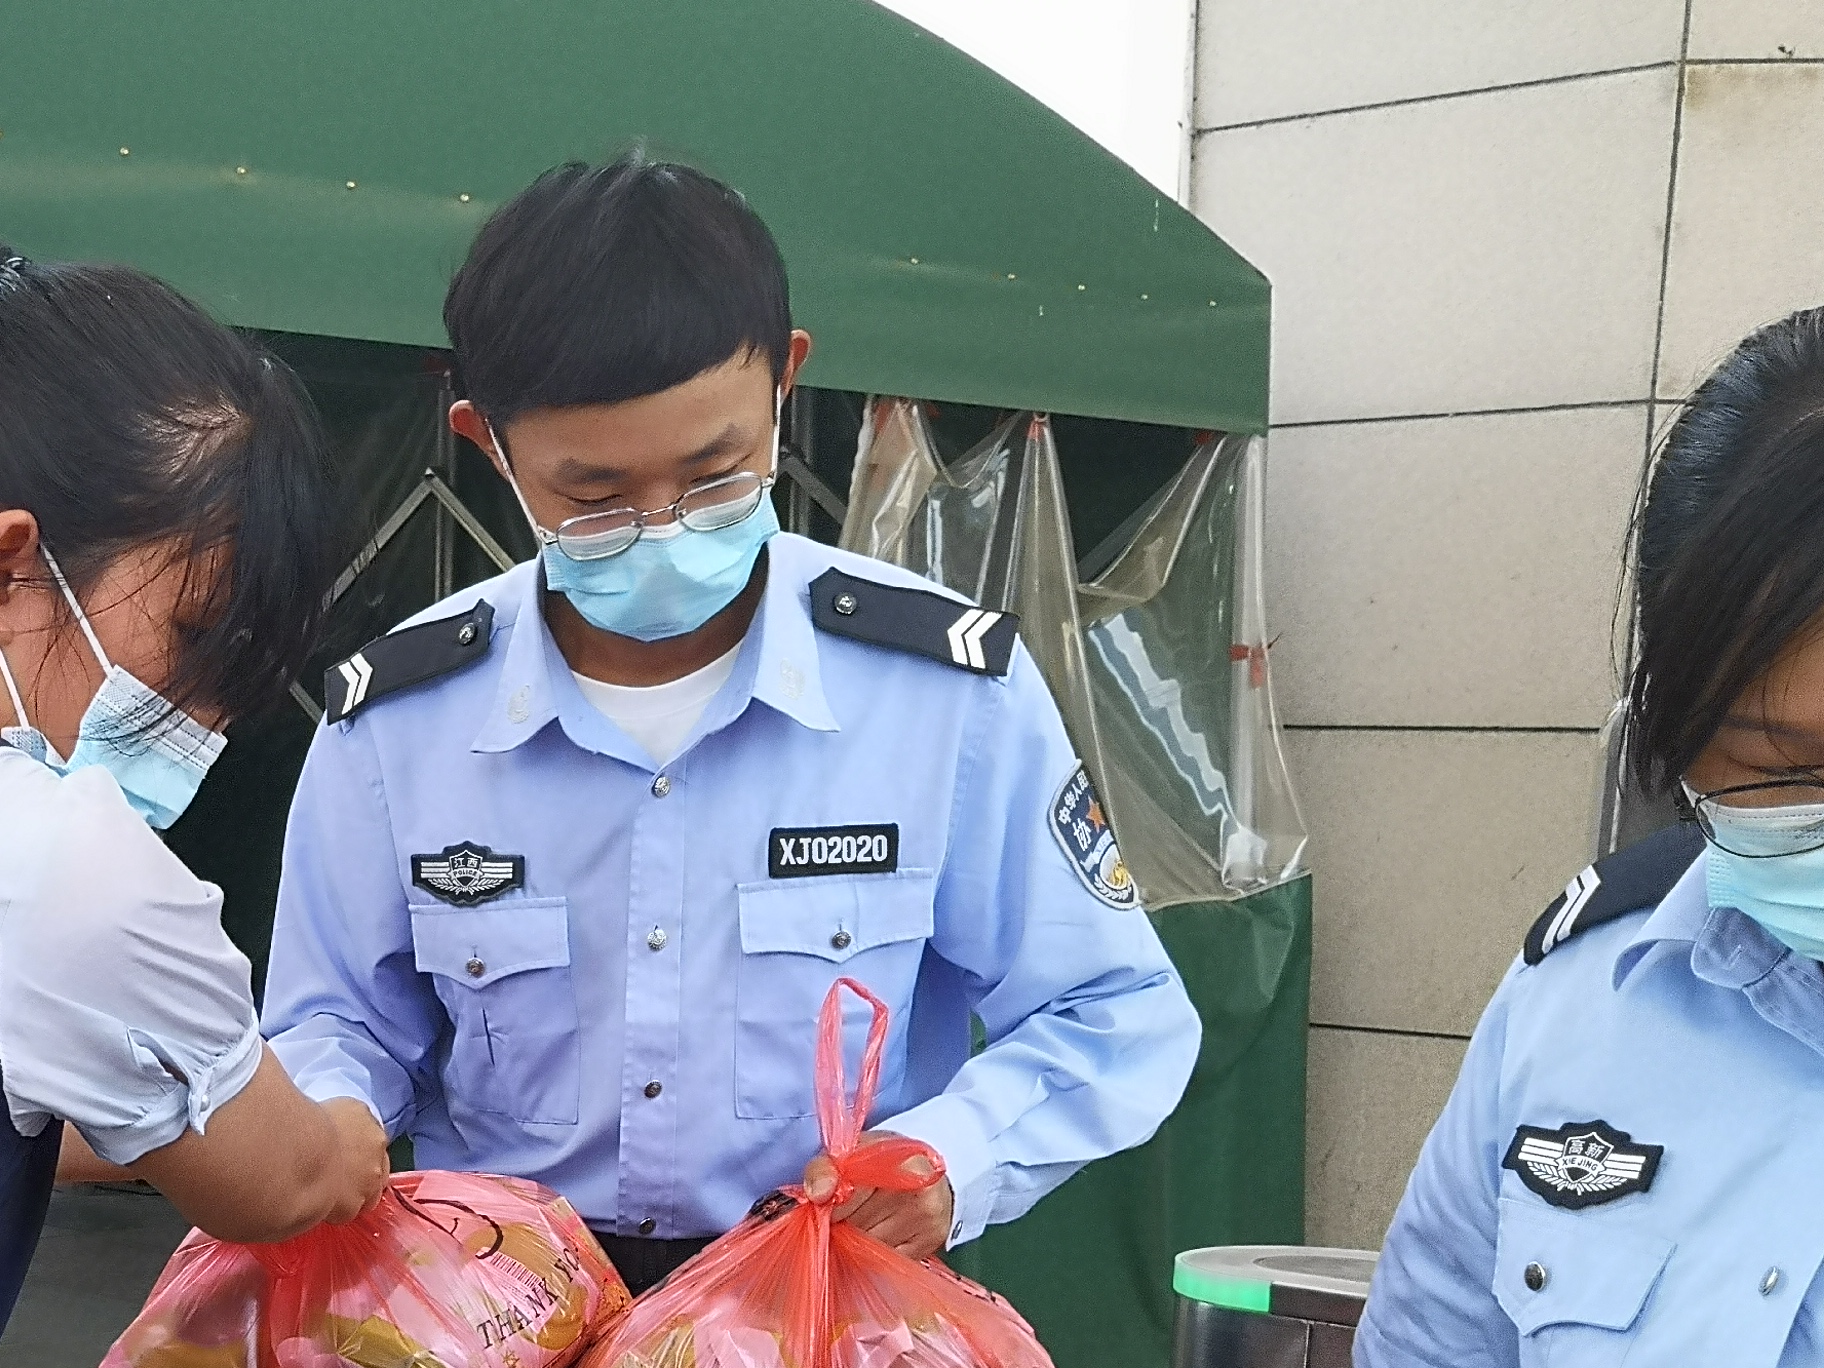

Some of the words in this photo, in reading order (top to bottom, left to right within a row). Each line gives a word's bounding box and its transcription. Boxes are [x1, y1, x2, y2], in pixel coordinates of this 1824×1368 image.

[454, 857, 479, 868] 江西
[779, 834, 888, 866] XJ02020
[1569, 1139, 1605, 1158] 高新
[477, 1277, 559, 1349] THANK
